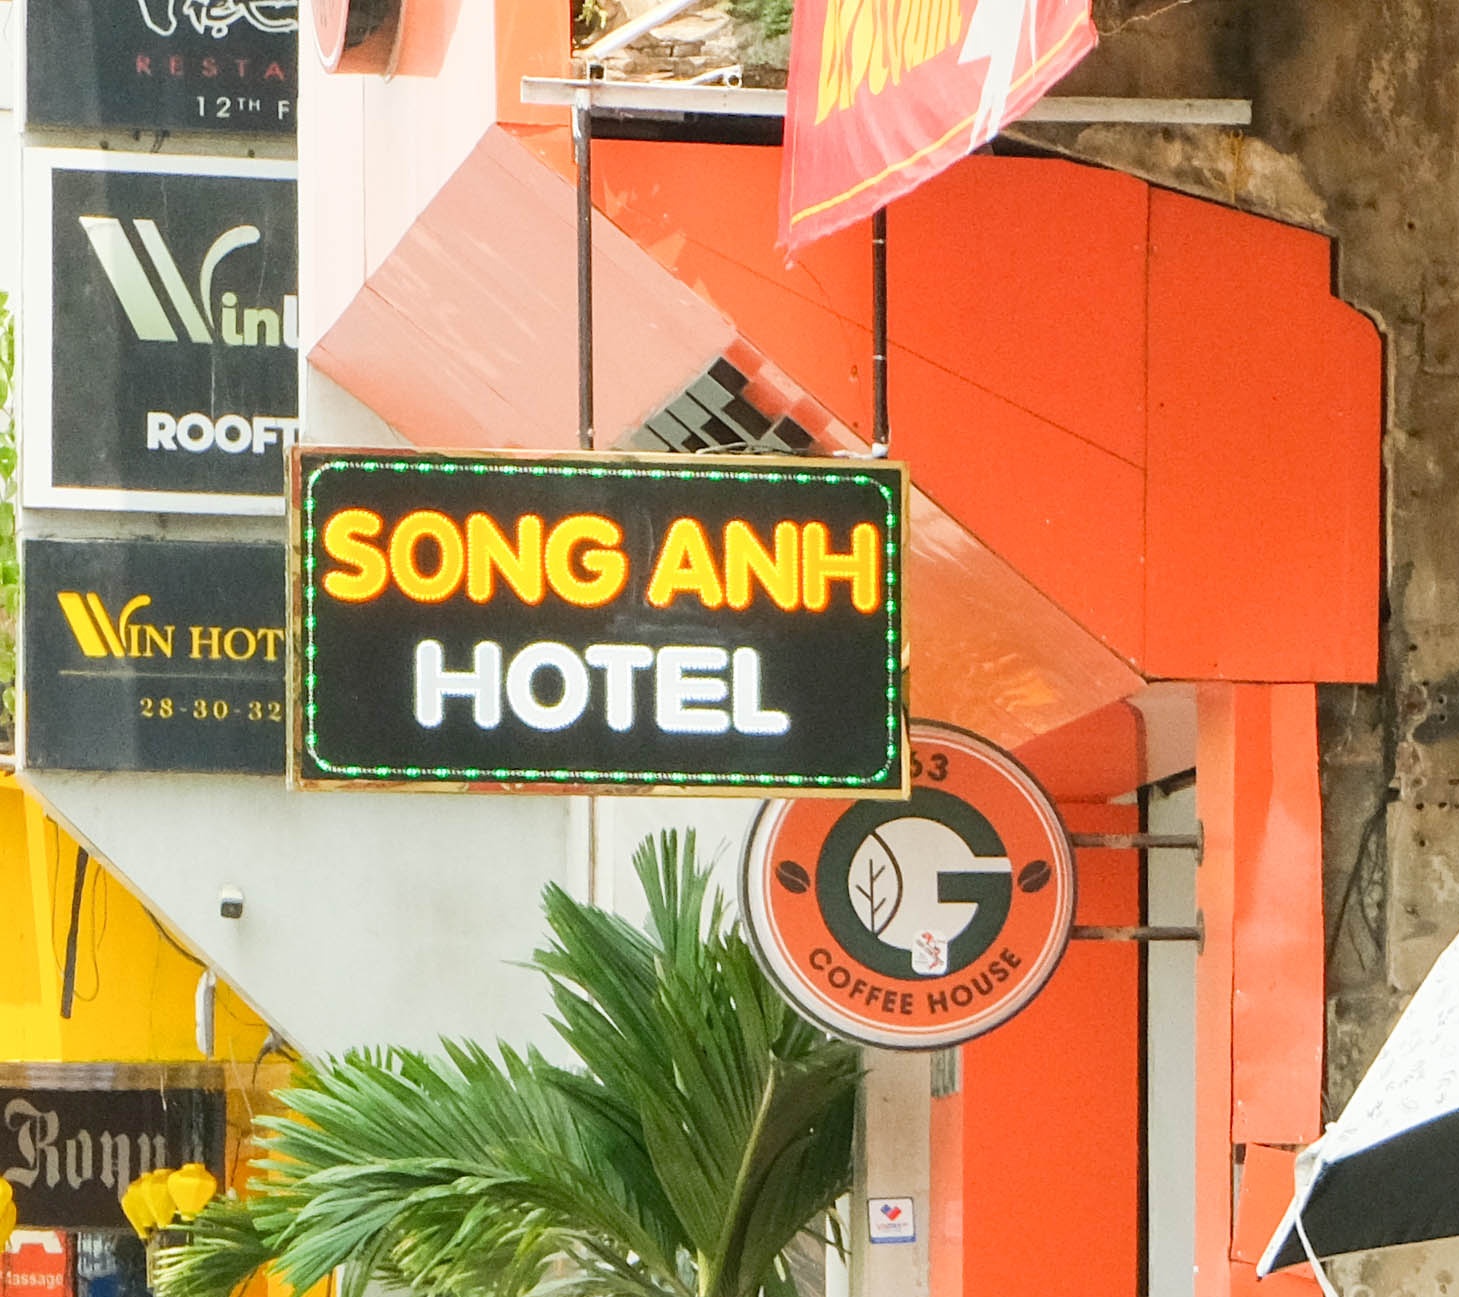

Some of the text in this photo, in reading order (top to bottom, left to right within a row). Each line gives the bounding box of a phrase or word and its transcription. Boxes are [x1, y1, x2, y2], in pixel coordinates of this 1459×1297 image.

[136, 54, 286, 80] RESTA
[322, 508, 881, 614] SONG ANH
[188, 625, 285, 662] HOT
[414, 639, 792, 736] HOTEL
[808, 947, 1023, 1015] COFFEE HOUSE
